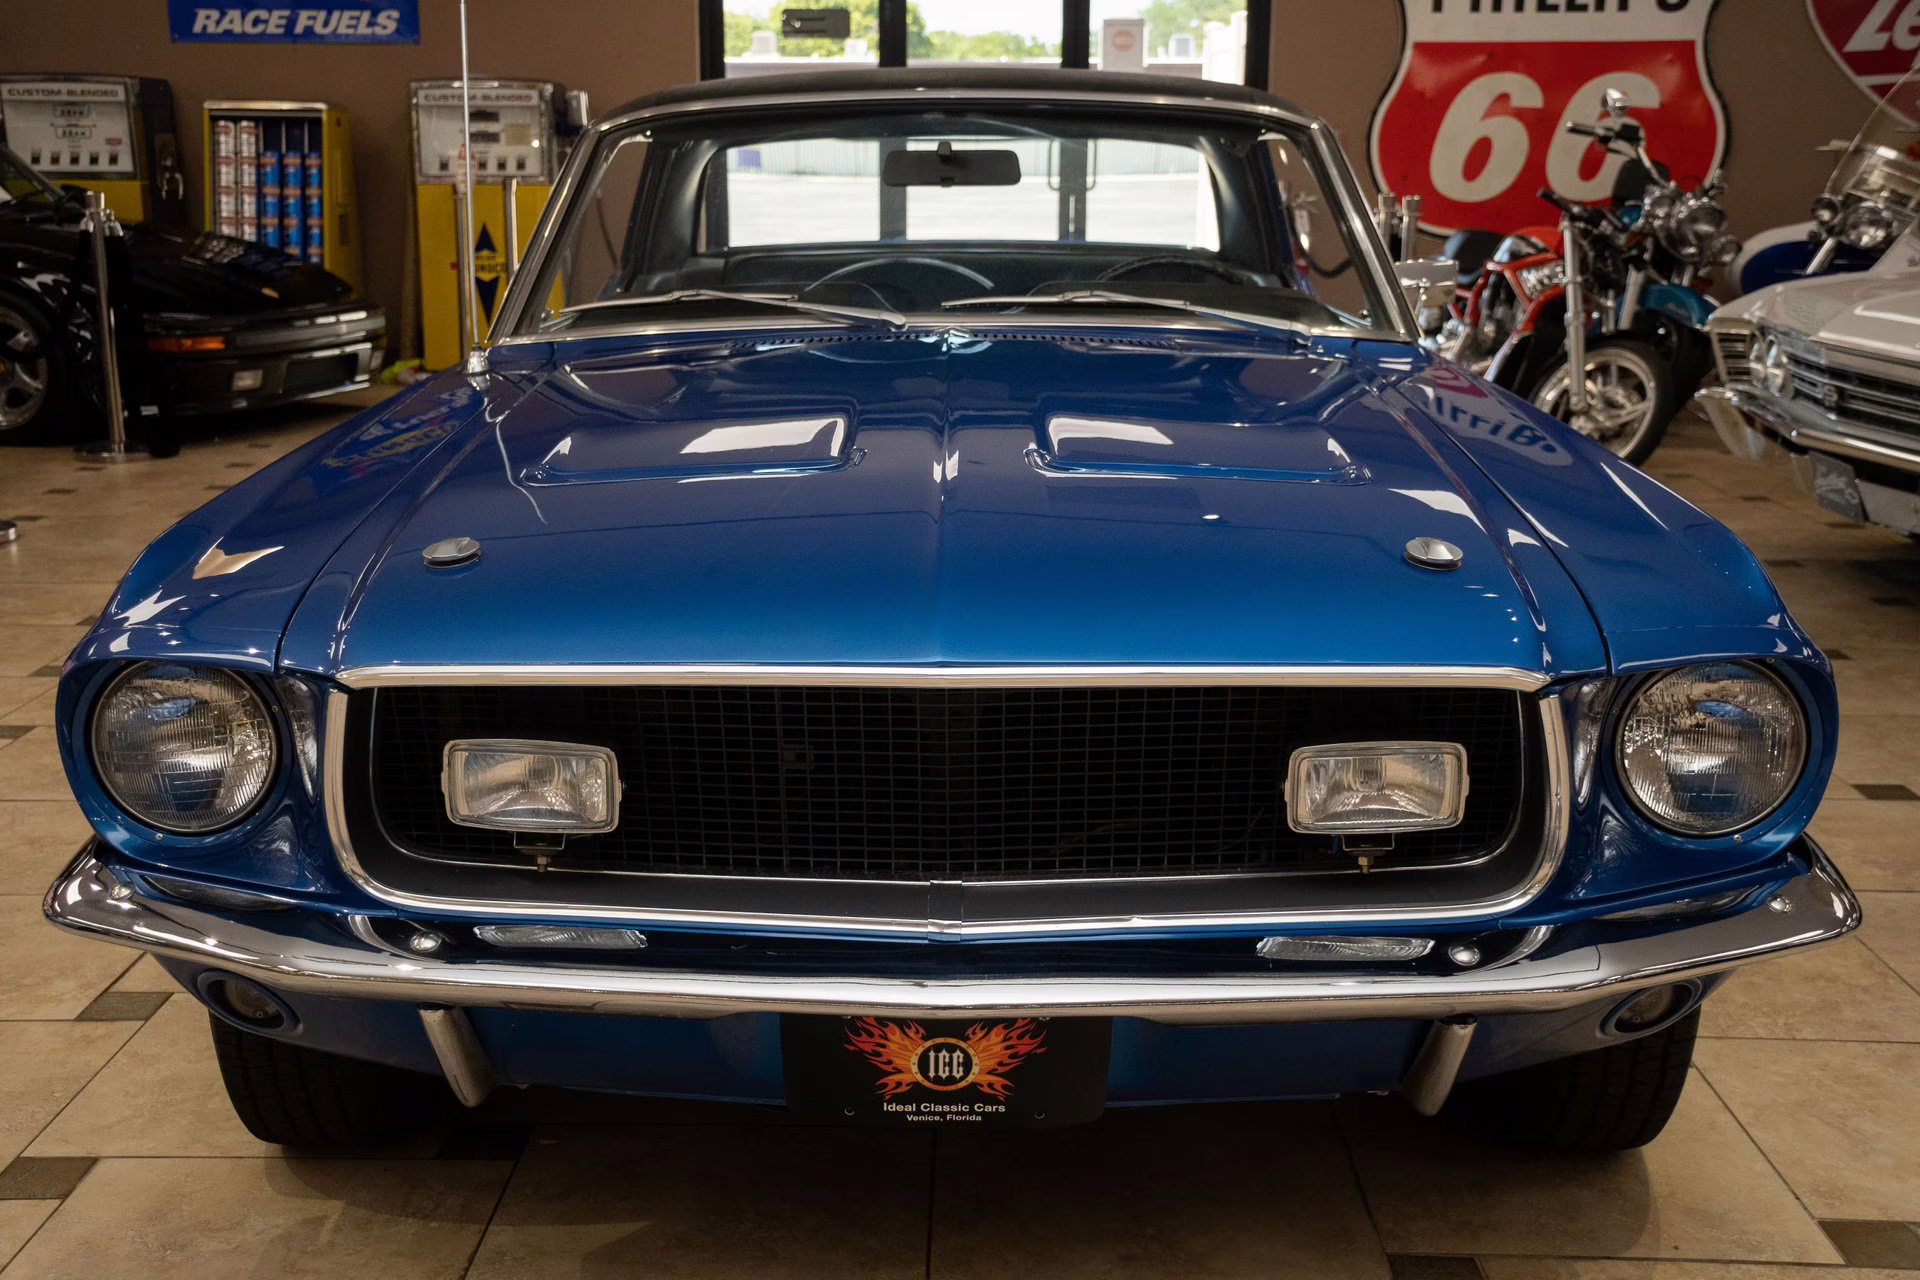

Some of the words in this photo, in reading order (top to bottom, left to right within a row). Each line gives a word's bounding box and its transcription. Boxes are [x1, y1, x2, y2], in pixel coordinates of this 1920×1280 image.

[192, 8, 291, 34] RACE
[293, 9, 400, 36] FUELS
[1429, 71, 1661, 203] 66
[883, 1102, 916, 1112] Ideal
[920, 1103, 970, 1112] Classic
[974, 1103, 1006, 1112] Cars
[906, 1114, 943, 1122] Venice,
